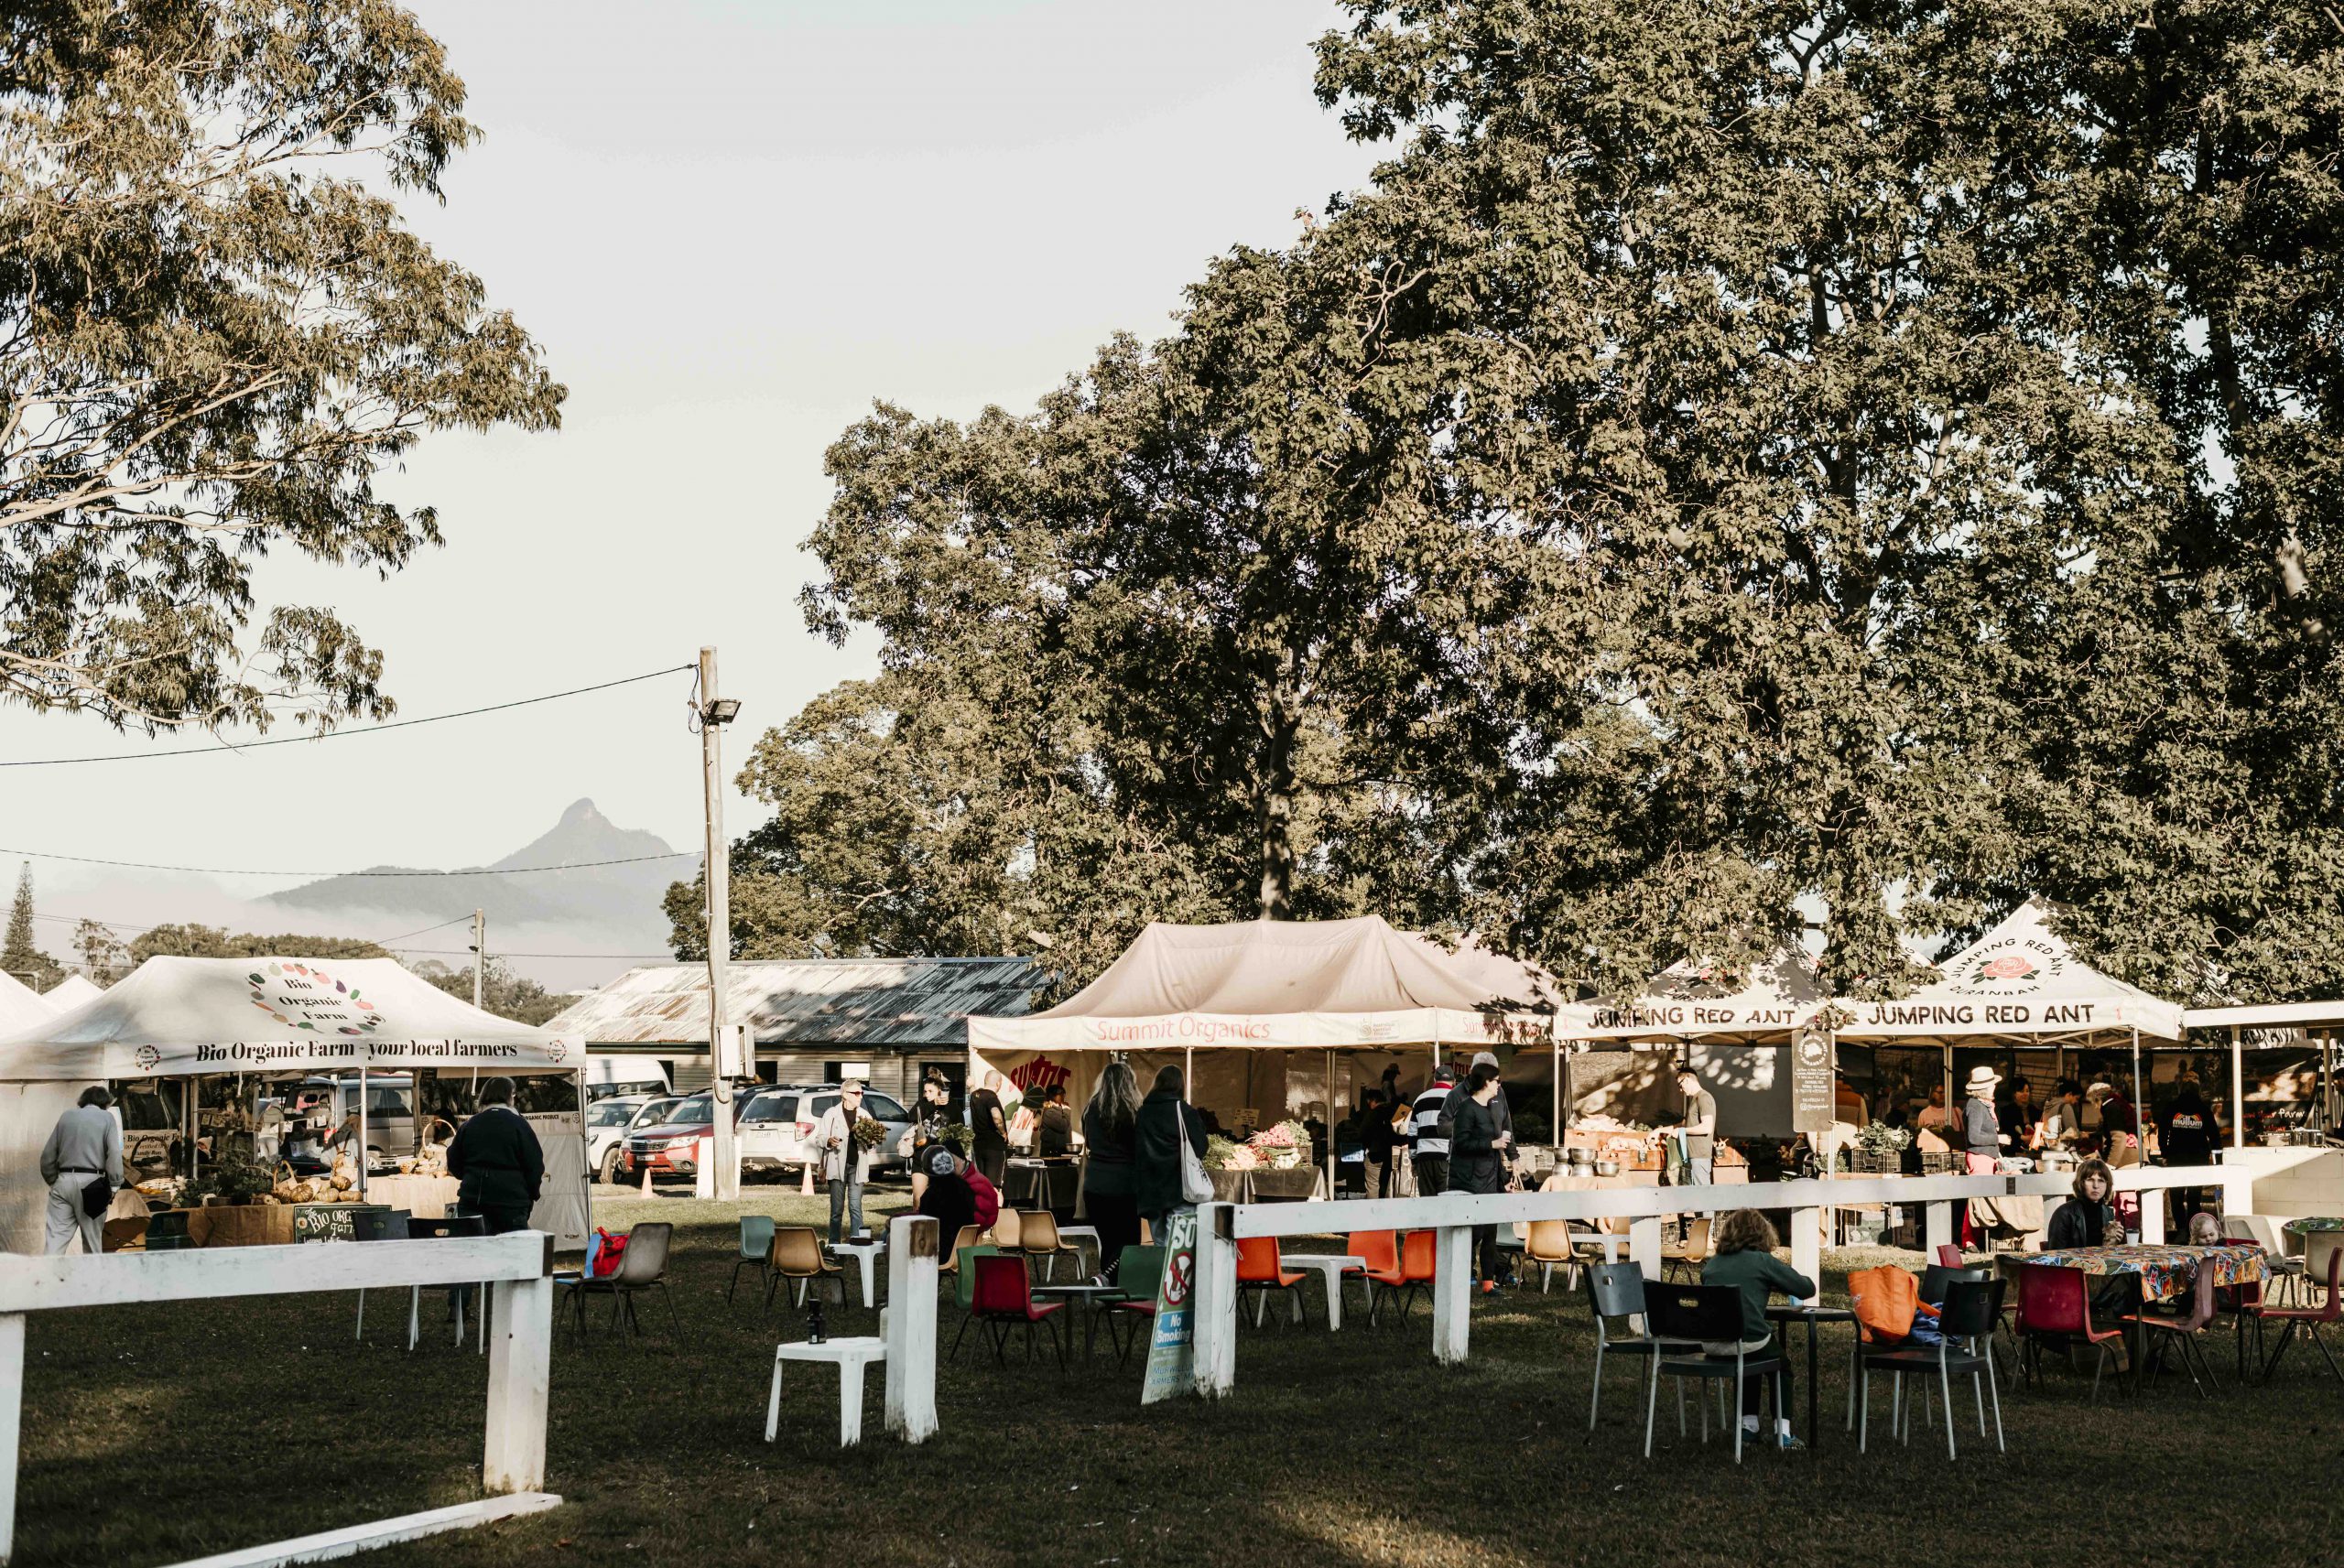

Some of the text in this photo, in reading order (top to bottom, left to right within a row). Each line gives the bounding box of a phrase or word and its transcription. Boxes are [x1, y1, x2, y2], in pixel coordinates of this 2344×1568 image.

[1951, 938, 2064, 978] JUMPING RED ANT
[284, 979, 312, 989] Bio
[1949, 985, 2040, 996] DURANBAH
[278, 996, 342, 1008] Organic
[302, 1011, 349, 1020] Farm
[1588, 1007, 1796, 1030] JUMPING RED ANT
[1868, 1004, 2095, 1025] JUMPING RED ANT
[1098, 1016, 1270, 1043] Summit Organics
[196, 1044, 227, 1061] Bio
[232, 1042, 304, 1065] Organic
[309, 1041, 355, 1056] Farm
[367, 1043, 408, 1061] your
[411, 1039, 450, 1056] local
[453, 1039, 518, 1056] farmers
[127, 1134, 140, 1142] Bio
[308, 1212, 330, 1234] BIO
[1170, 1314, 1182, 1328] No
[1156, 1328, 1191, 1344] Smoking
